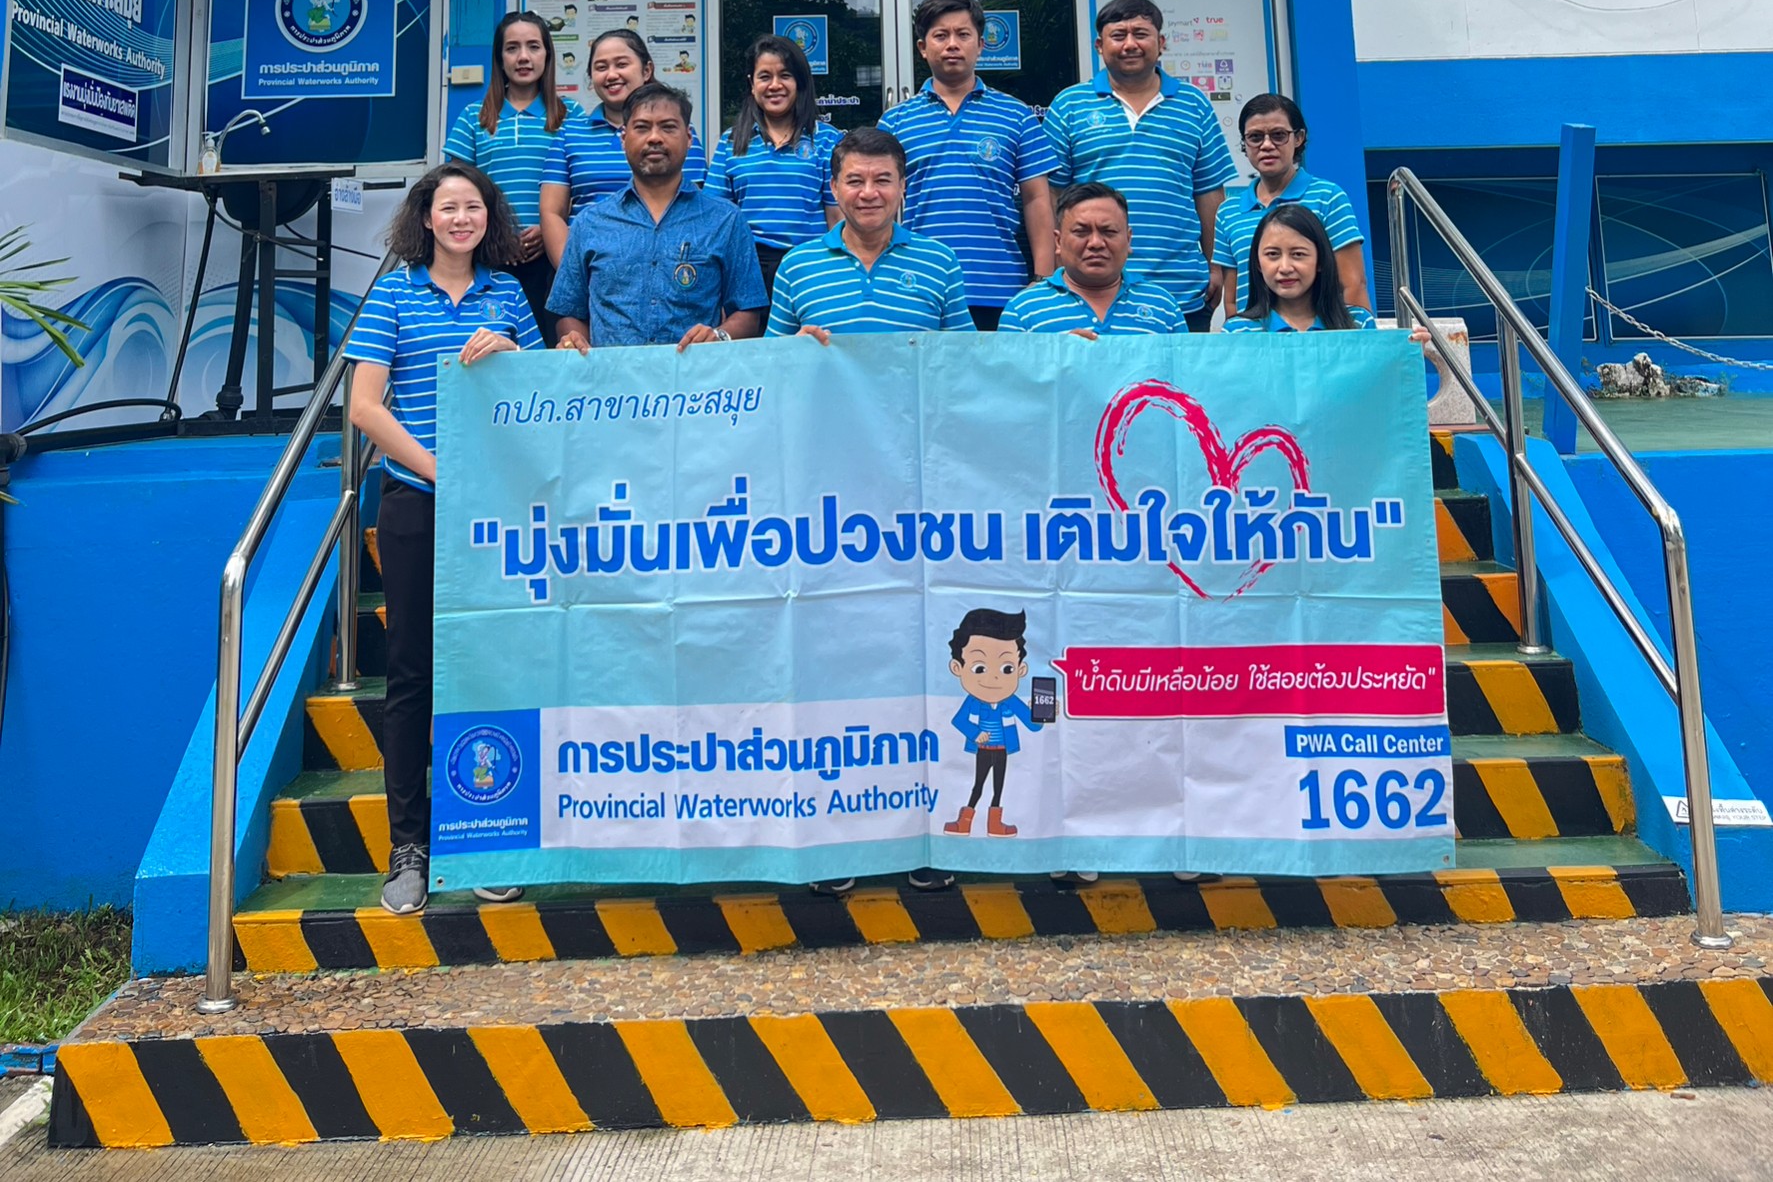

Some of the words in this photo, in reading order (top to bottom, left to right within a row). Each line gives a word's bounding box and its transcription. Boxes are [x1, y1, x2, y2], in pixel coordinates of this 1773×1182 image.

[12, 1, 63, 37] Provincial
[67, 22, 123, 60] Waterworks
[126, 47, 165, 80] Authority
[259, 61, 379, 76] การประปาส่วนภูมิภาค
[298, 78, 342, 86] Waterworks
[344, 76, 379, 85] Authority
[492, 384, 763, 426] กปภ.สาขาเกาะสมุย
[472, 475, 1003, 601] "มุ่งมั่นเพื่อปวงชน
[1025, 489, 1402, 562] เติมใจให้กัน"
[1075, 659, 1239, 692] "น้ำดิบมีเหลือน้อย
[1248, 663, 1436, 690] ใช้สอยต้องประหยัด"
[1035, 695, 1055, 705] 1662
[558, 725, 940, 781] การประปาส่วนภูมิภาค
[1296, 734, 1337, 753] PWA
[1340, 733, 1378, 753] Call
[1383, 734, 1444, 753] Center
[558, 792, 666, 820] Provincial
[674, 792, 817, 819] Waterworks
[827, 783, 939, 815] Authority
[1299, 769, 1447, 830] 1662
[439, 817, 528, 832] การประปาส่วนภูมิภาค
